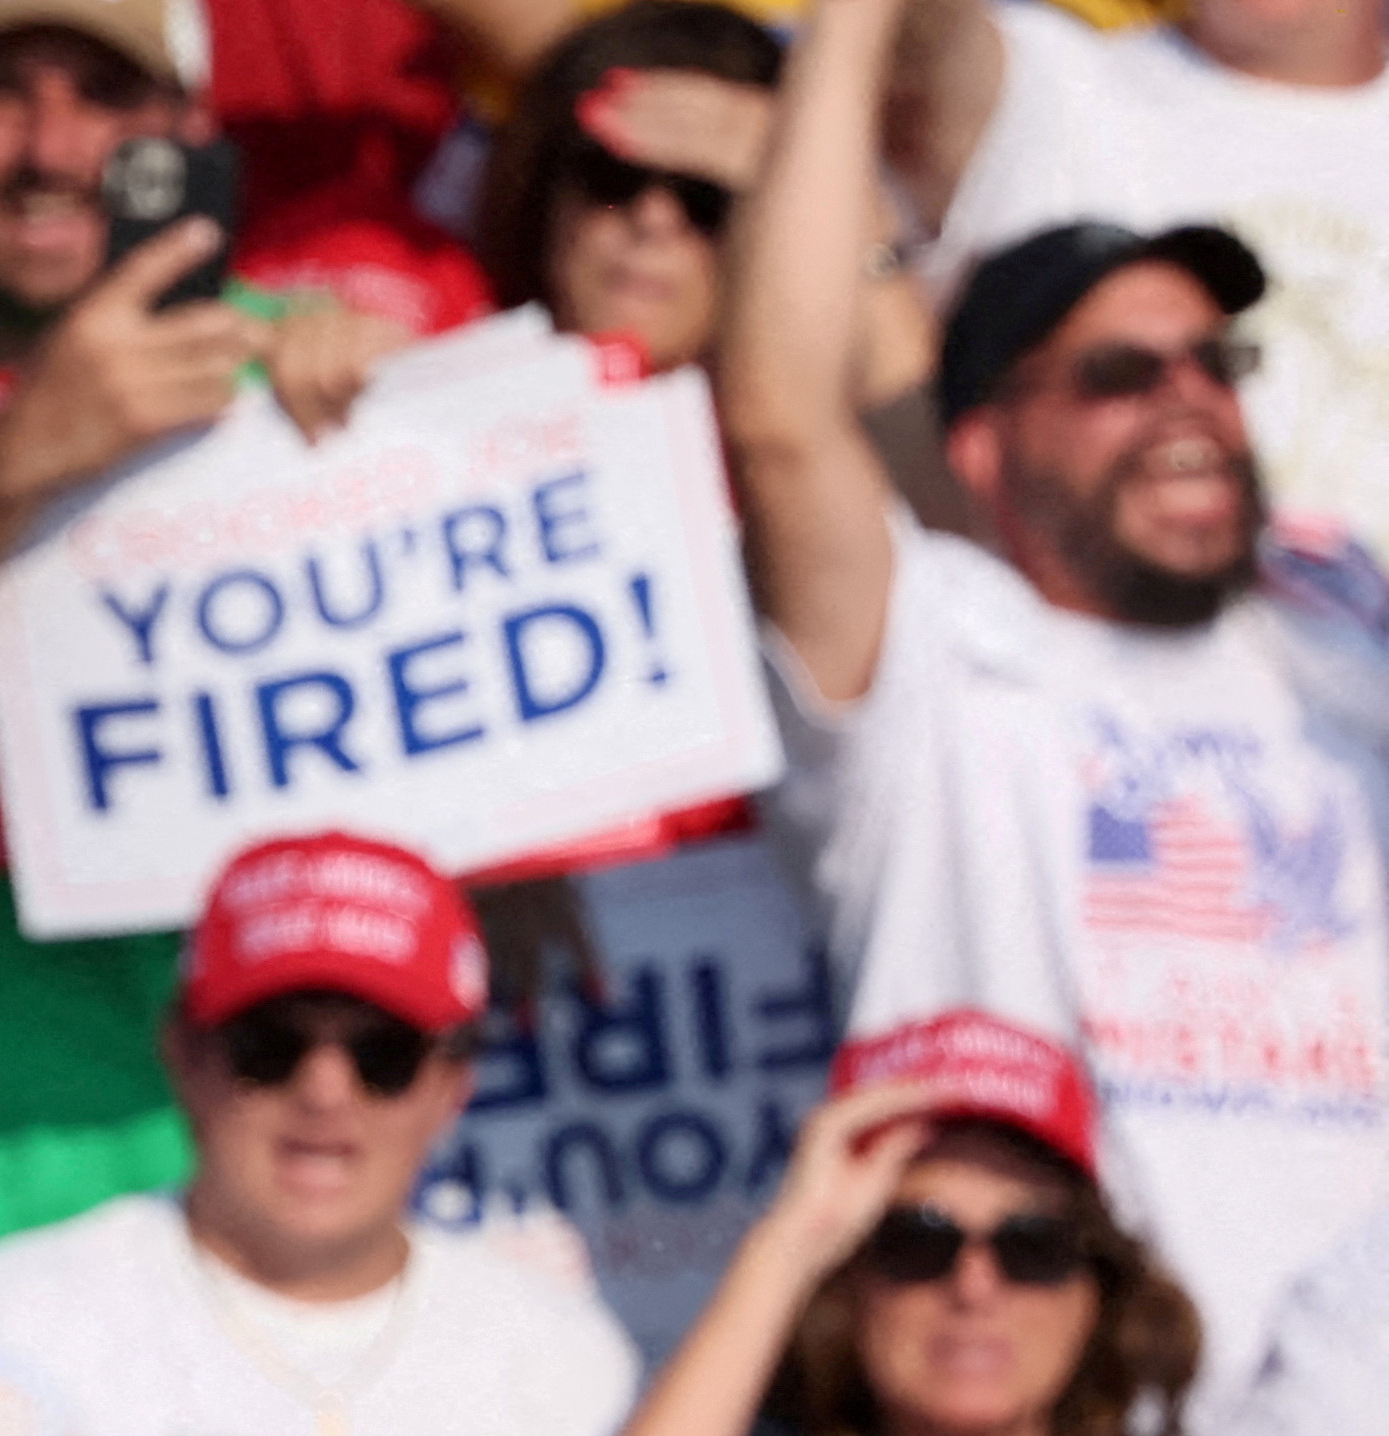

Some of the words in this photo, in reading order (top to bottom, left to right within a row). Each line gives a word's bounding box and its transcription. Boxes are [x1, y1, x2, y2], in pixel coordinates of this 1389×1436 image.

[97, 471, 605, 670] YOU'RE
[69, 569, 671, 816] FIRED!
[463, 938, 845, 1112] FIRE
[413, 1095, 803, 1230] YOU'R
